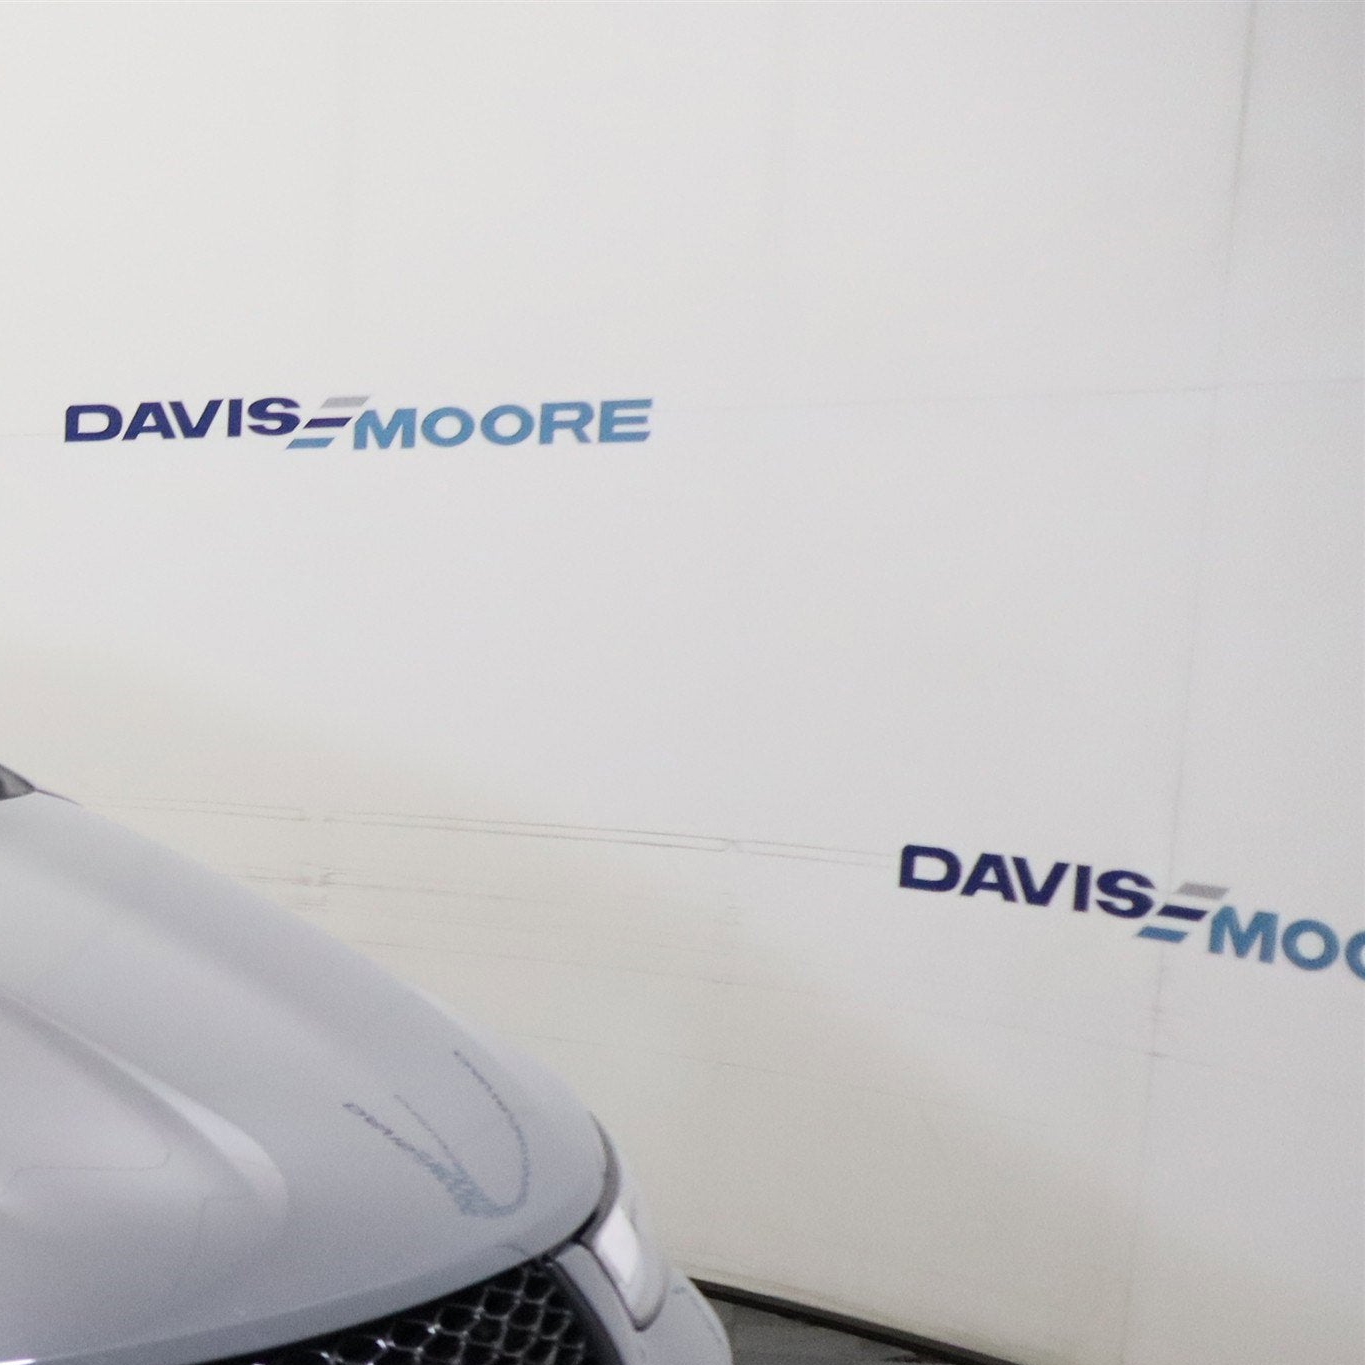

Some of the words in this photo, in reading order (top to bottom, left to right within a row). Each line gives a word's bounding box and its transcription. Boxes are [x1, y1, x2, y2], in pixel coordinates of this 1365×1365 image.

[64, 396, 301, 443] DAVIS
[352, 398, 654, 451] MOORE
[899, 843, 1157, 919] DAVIS
